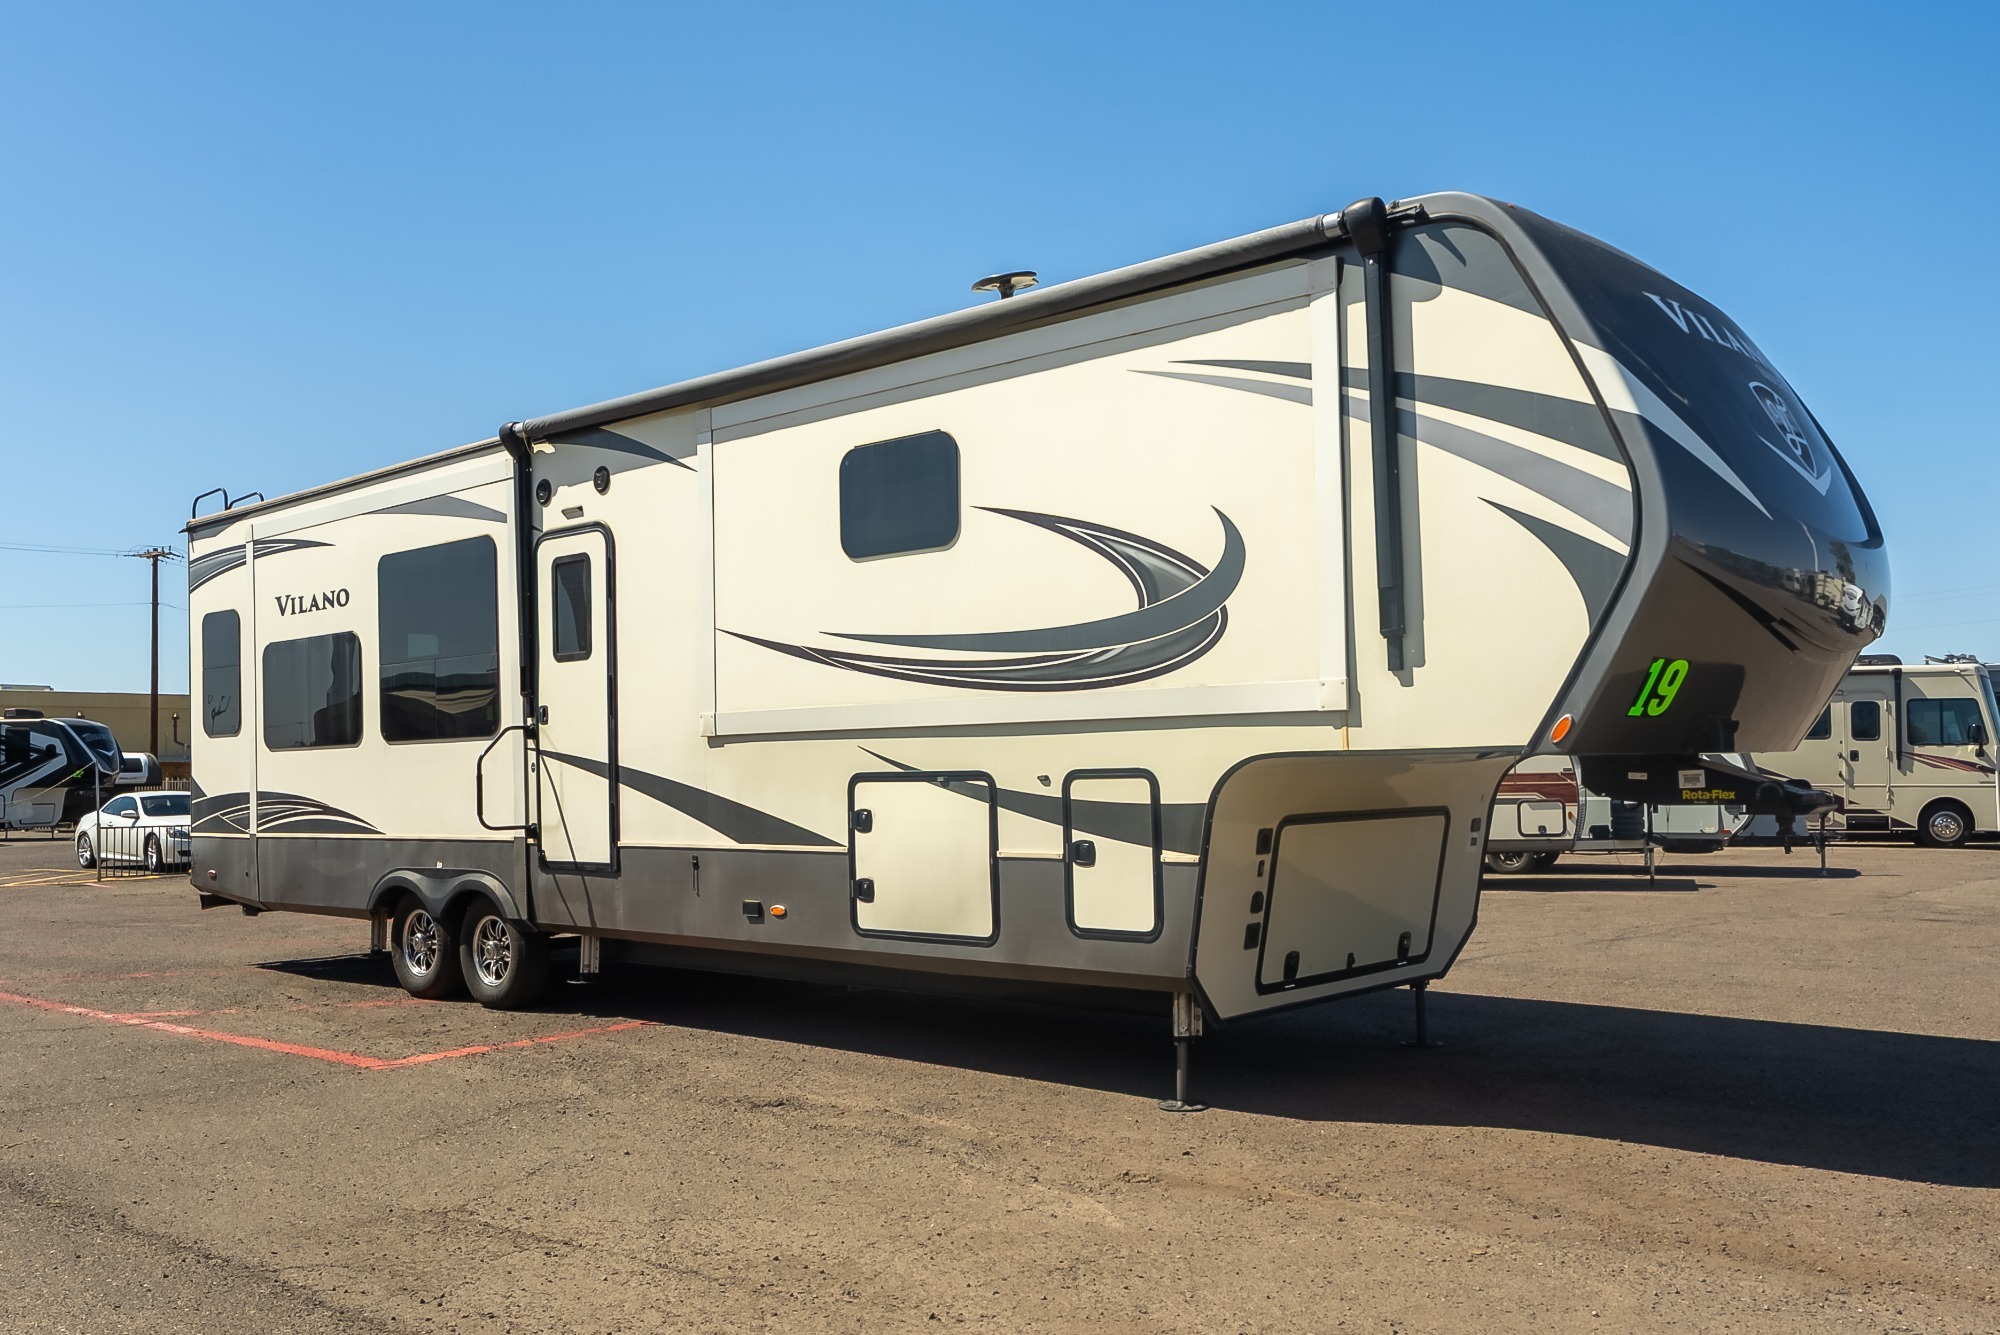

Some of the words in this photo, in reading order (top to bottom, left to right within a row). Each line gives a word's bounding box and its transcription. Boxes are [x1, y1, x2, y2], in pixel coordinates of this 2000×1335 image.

[1641, 290, 1777, 375] VILAN
[274, 588, 350, 617] VILANO
[1627, 658, 1690, 717] 19
